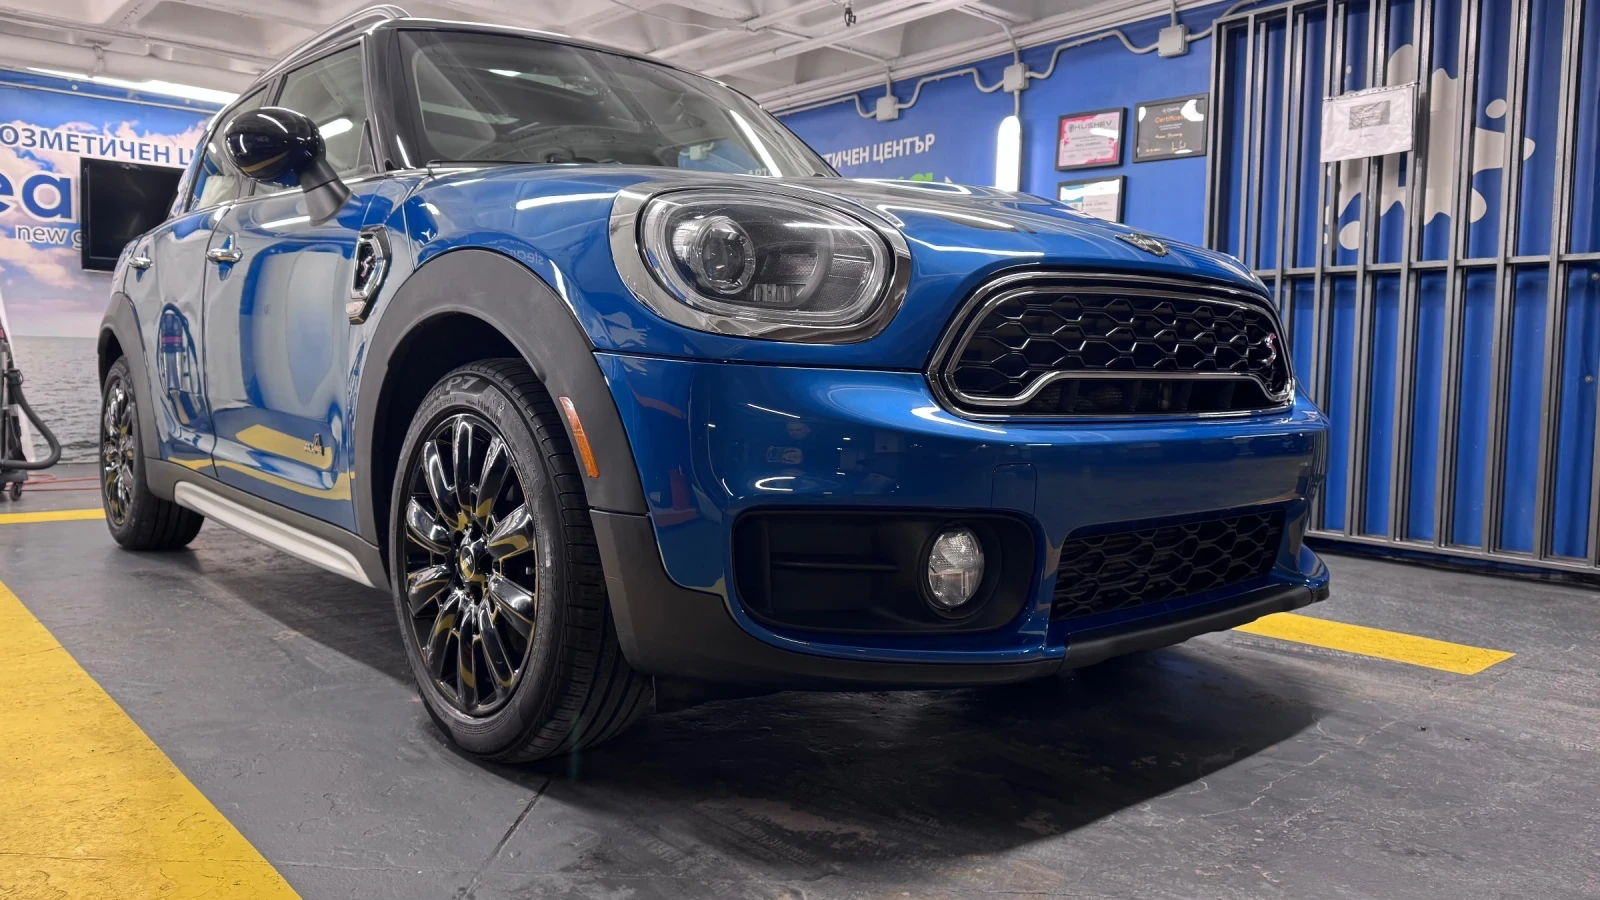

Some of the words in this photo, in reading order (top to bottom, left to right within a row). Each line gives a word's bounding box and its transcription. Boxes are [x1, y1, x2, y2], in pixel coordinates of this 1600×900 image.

[0, 125, 170, 164] ОЗМЕТИЧЕН
[821, 146, 870, 169] ТИЧЕН
[872, 133, 935, 164] ЦЕНТЪР
[17, 226, 66, 243] new
[446, 376, 480, 391] P7
